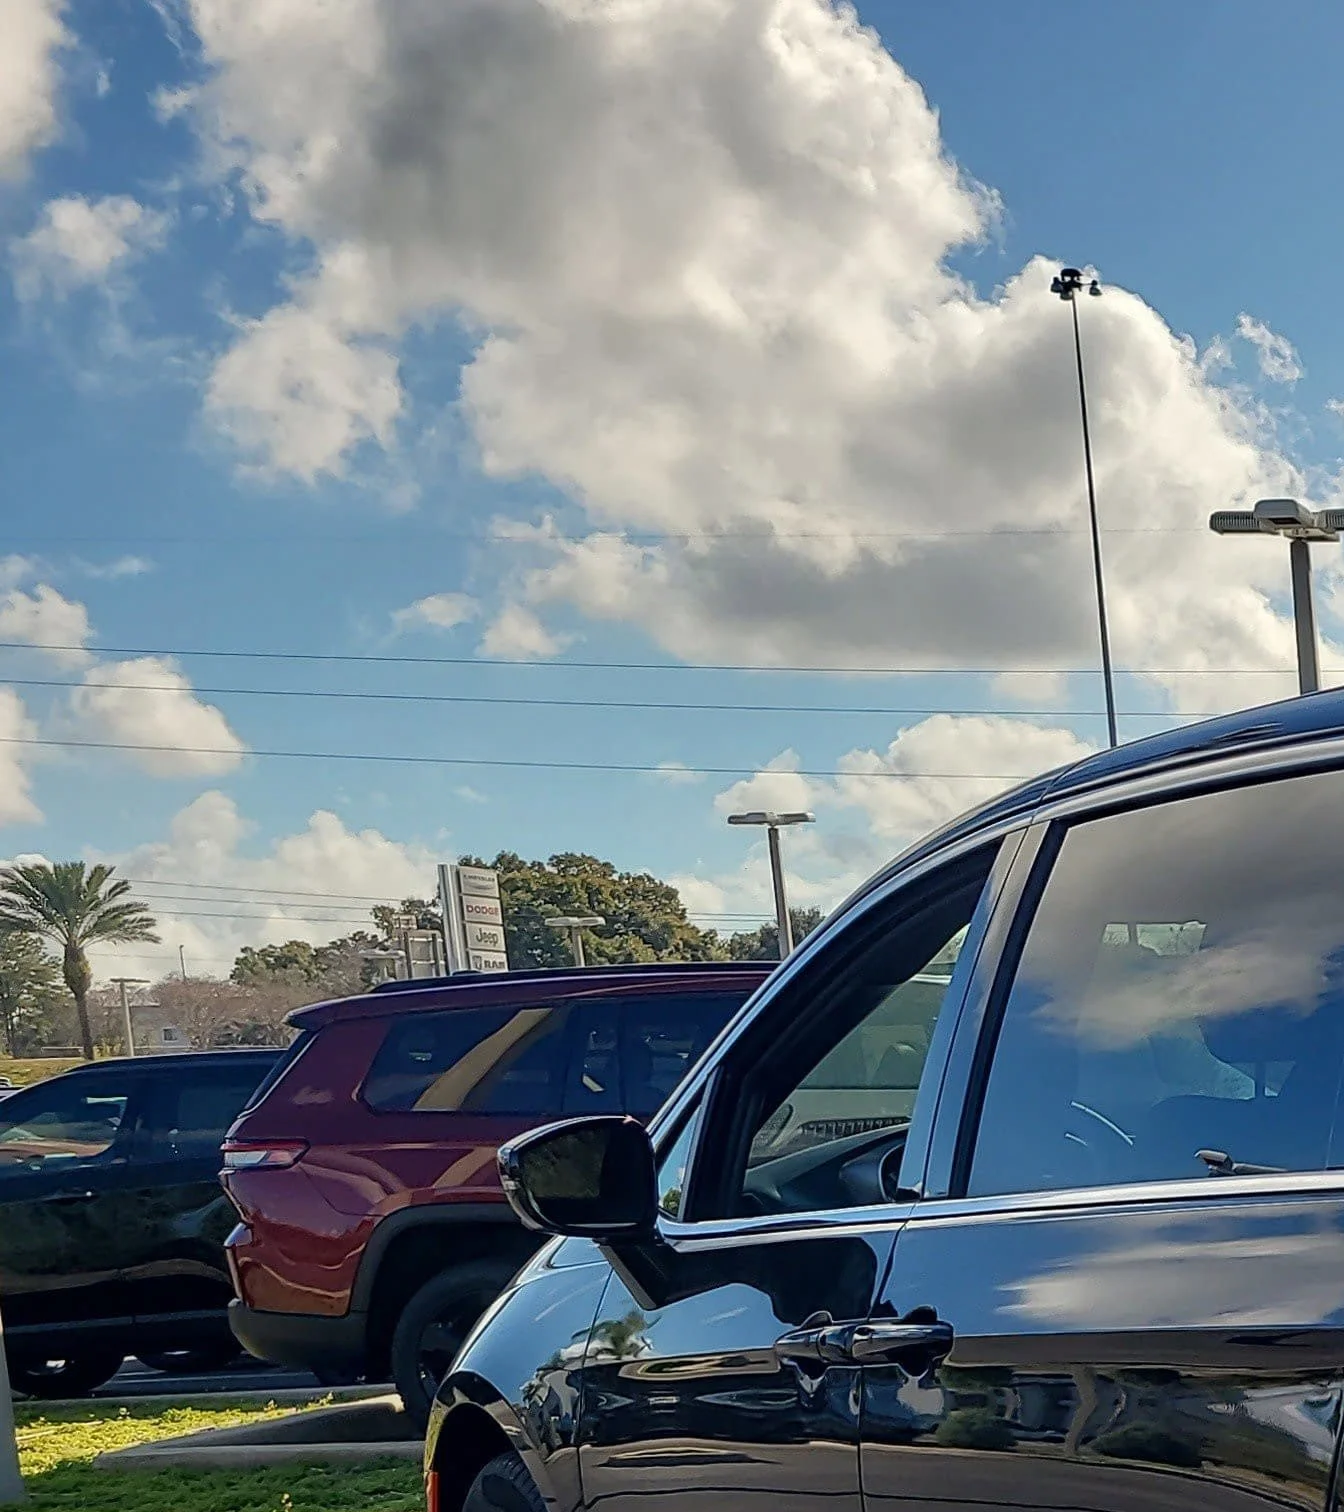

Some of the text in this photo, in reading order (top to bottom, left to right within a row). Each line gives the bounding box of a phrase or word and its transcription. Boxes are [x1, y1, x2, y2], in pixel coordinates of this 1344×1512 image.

[466, 904, 500, 916] DODGE
[475, 928, 499, 947] Jeep
[483, 960, 506, 970] RAM
